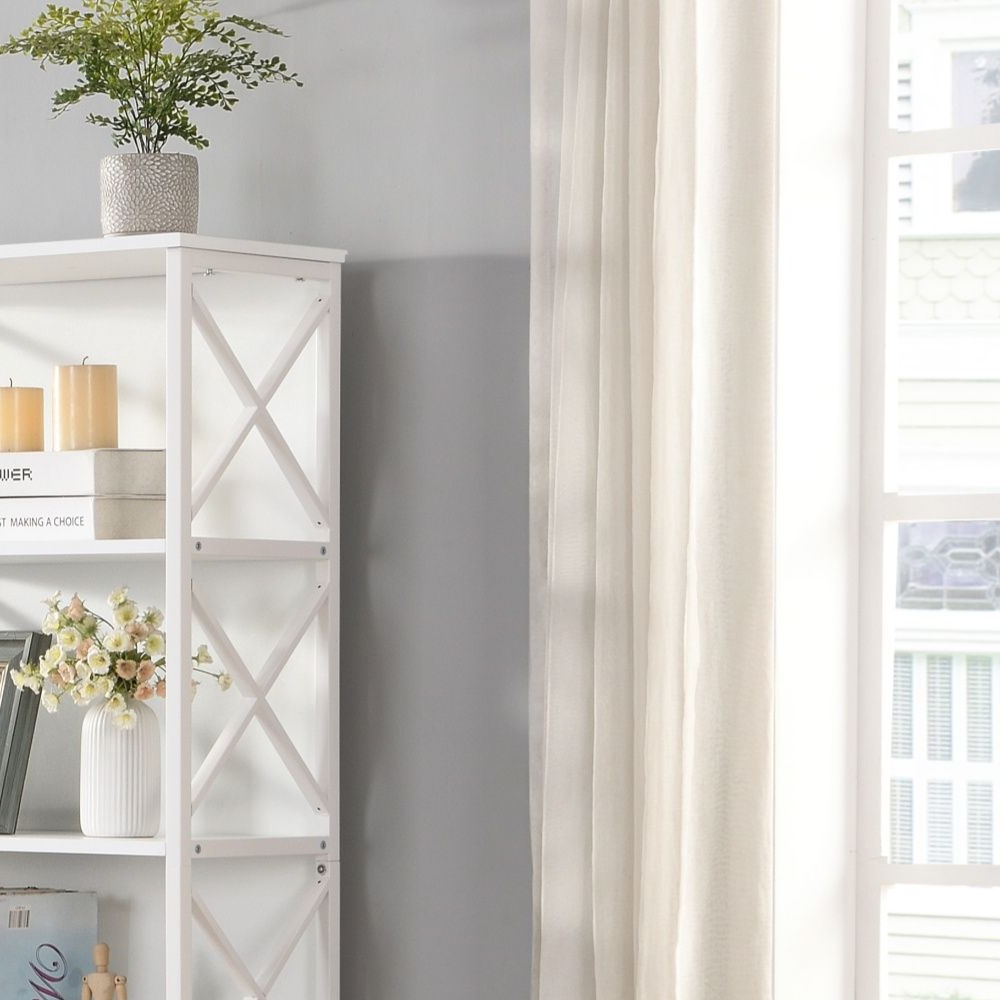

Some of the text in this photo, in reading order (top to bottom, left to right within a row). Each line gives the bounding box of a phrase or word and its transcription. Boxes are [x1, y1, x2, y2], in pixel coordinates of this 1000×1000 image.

[10, 517, 44, 527] MAKING
[46, 517, 52, 527] A
[53, 516, 85, 527] CHOICE
